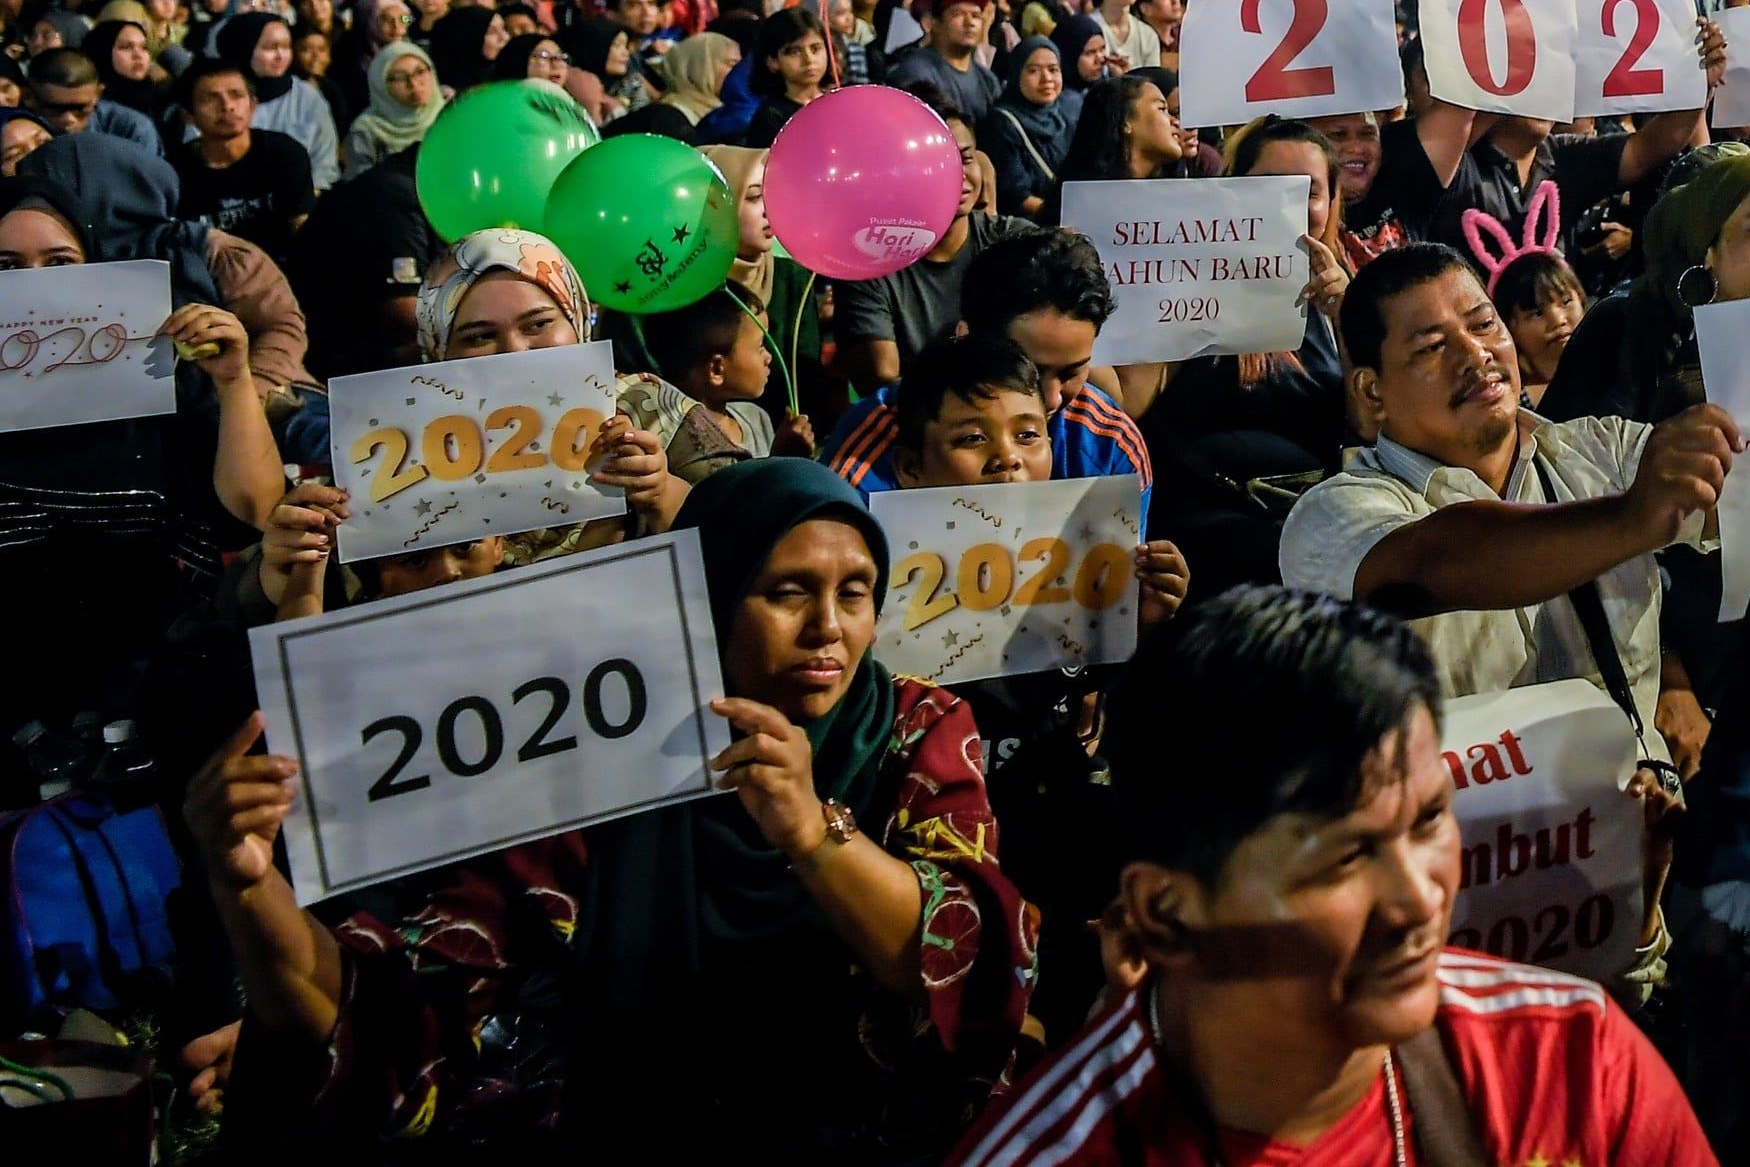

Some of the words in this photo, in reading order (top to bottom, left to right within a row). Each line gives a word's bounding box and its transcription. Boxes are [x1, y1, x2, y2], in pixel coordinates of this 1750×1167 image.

[864, 227, 915, 246] Hari
[1113, 218, 1264, 247] SELAMAT
[1100, 259, 1200, 285] AHUN
[1210, 255, 1294, 282] BARU
[1158, 297, 1220, 324] 2020
[0, 323, 128, 373] 020
[350, 405, 608, 503] 2020
[890, 536, 1132, 632] 2020
[360, 657, 648, 802] 2020
